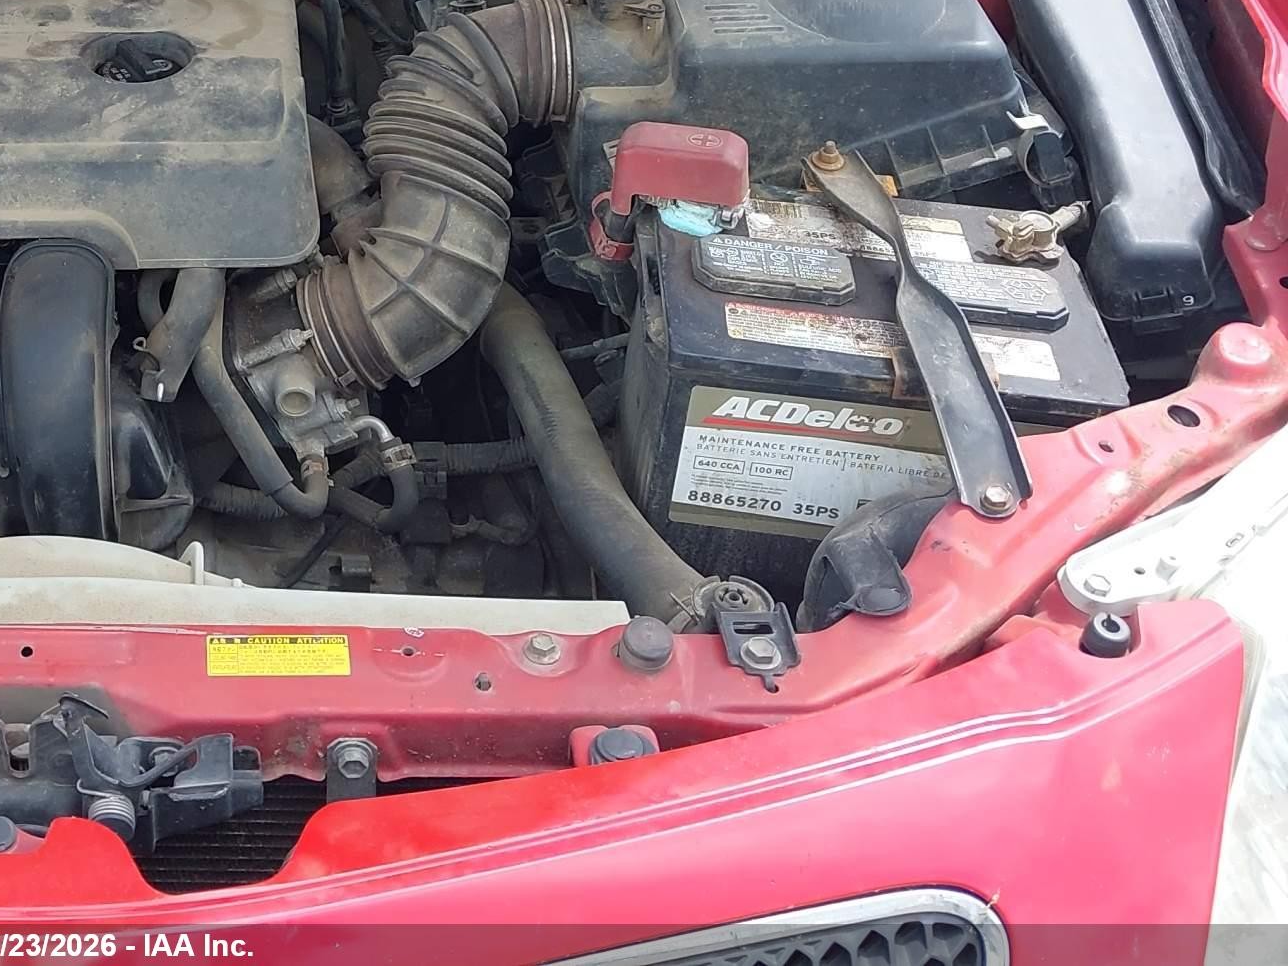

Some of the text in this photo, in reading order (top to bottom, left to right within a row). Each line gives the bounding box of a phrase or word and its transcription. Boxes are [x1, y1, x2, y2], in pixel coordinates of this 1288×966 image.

[724, 238, 773, 250] DANGER
[784, 245, 828, 256] POISON
[712, 395, 904, 435] ACDelco
[696, 443, 746, 455] BATTERIE
[750, 450, 777, 459] SANS
[780, 453, 839, 467] ENTRETIEN
[898, 468, 929, 477] LIBRE
[699, 434, 880, 461] MAINTENANCE FREE BATTERY
[698, 459, 789, 477] 640 CCA 100 RC
[687, 490, 782, 512] 88865270
[792, 503, 840, 520] 35PS
